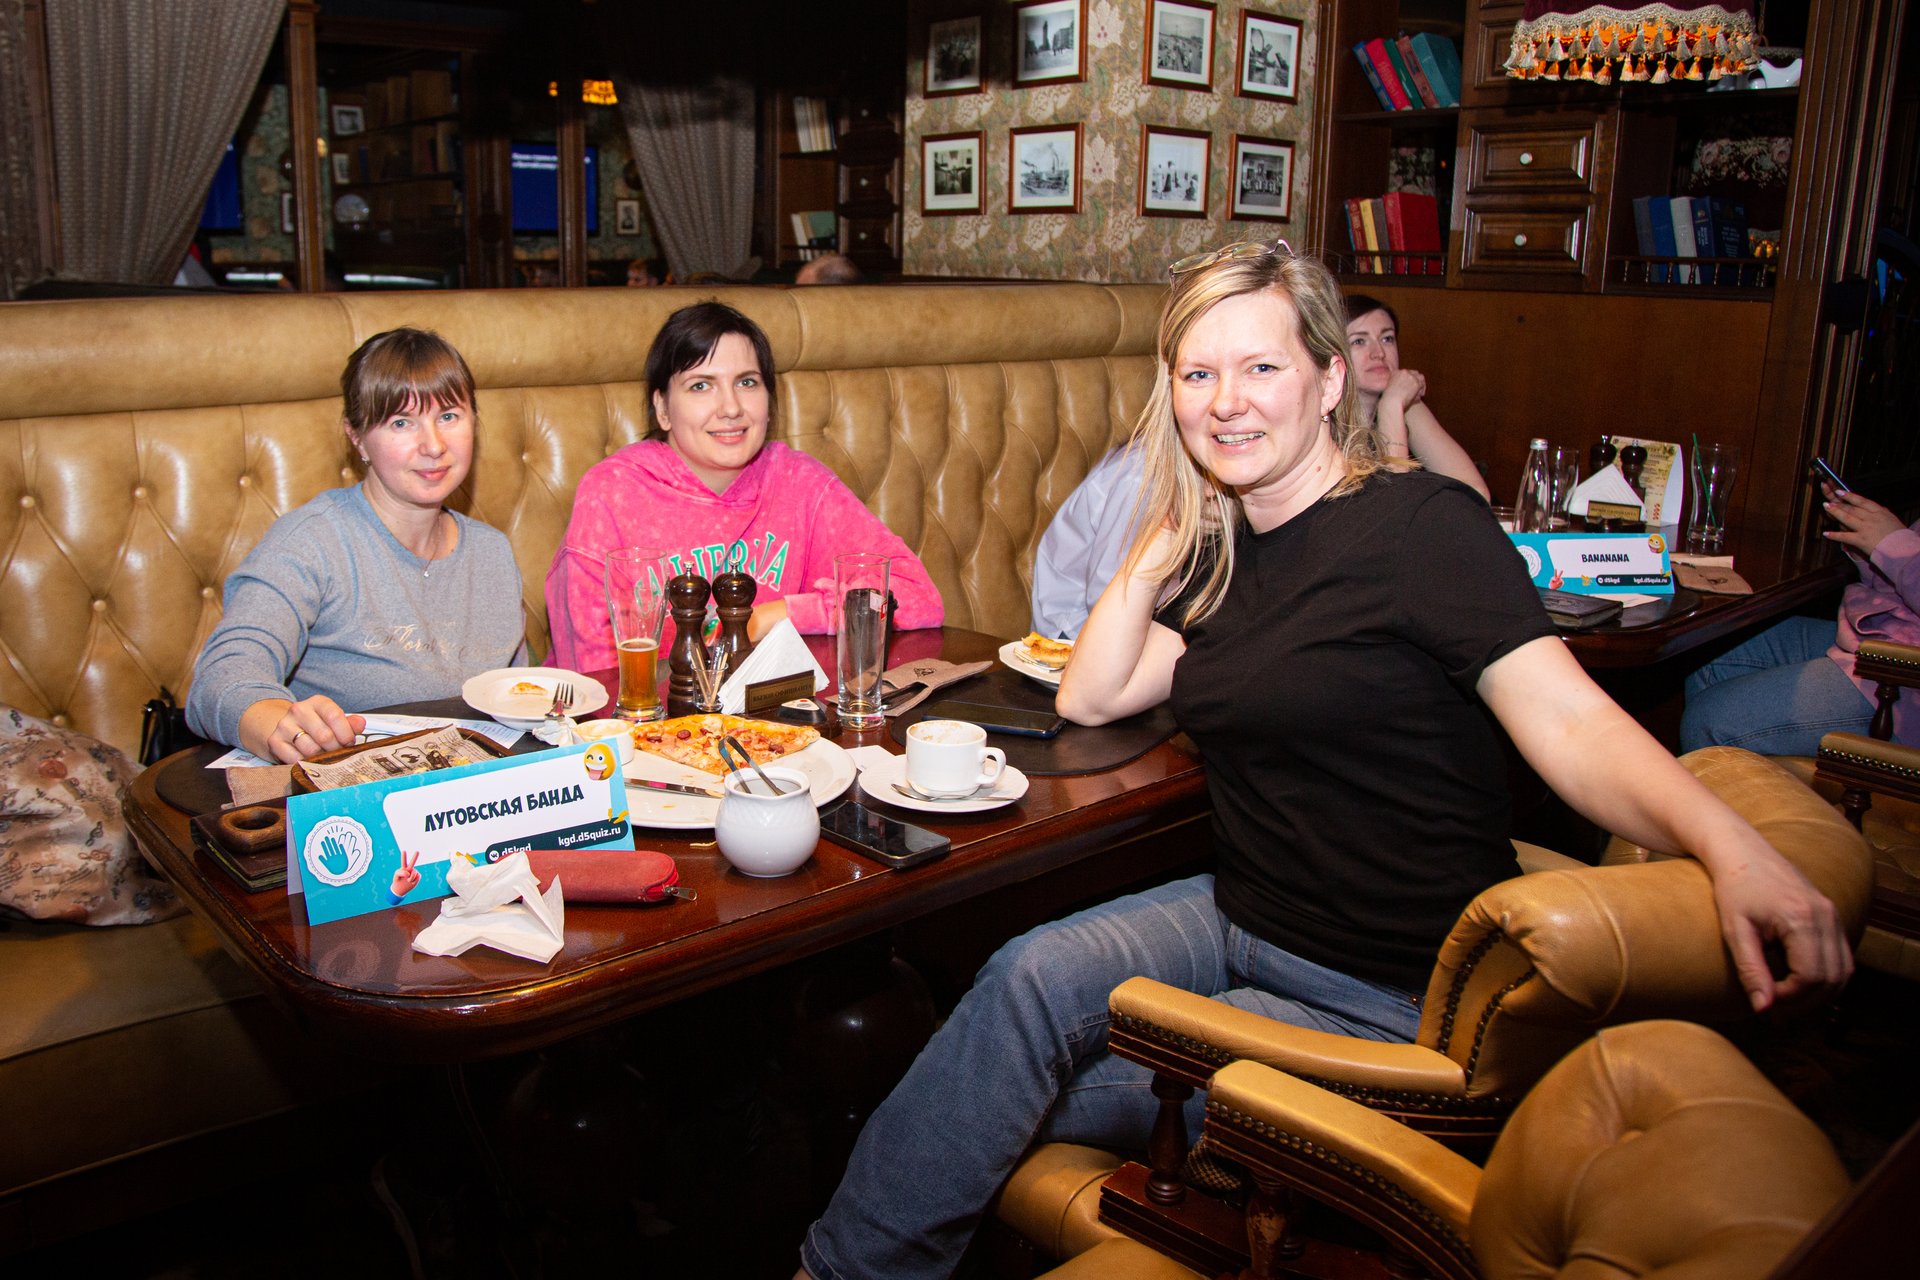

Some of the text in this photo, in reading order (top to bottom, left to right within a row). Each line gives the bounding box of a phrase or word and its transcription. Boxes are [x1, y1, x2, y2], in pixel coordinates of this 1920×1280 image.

[1581, 553, 1630, 563] BANANANA
[424, 784, 585, 832] ЛУГОВСКАЯ БАНДА
[558, 826, 621, 848] kgd.d5quiz.ru
